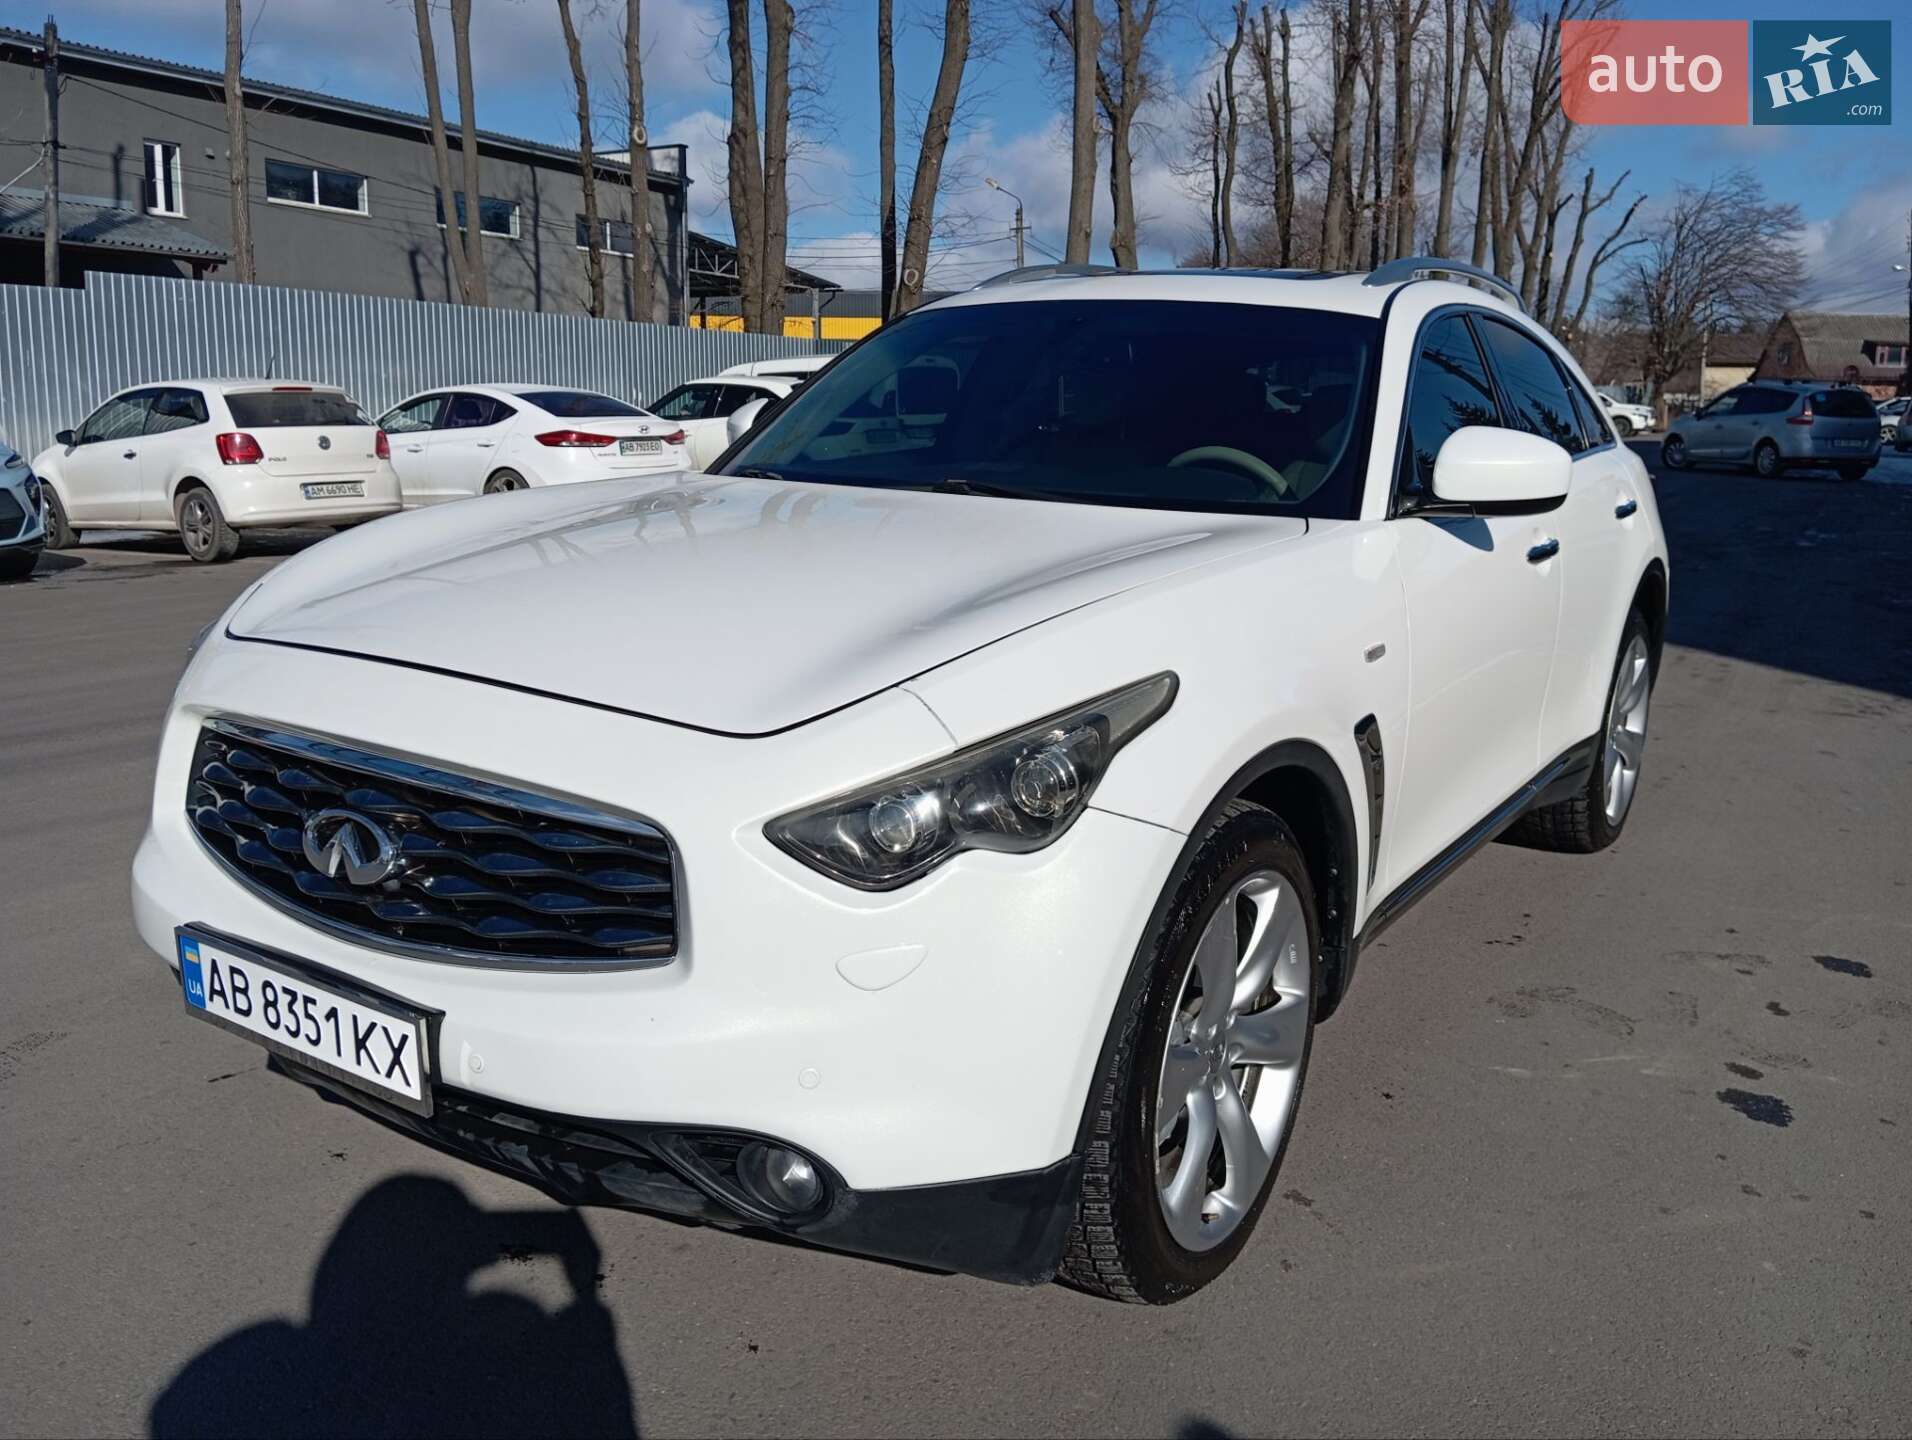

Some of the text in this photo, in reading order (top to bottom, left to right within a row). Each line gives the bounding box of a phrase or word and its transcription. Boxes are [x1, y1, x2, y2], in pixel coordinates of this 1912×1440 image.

[311, 486, 326, 496] AM
[326, 485, 347, 495] 6690
[188, 978, 204, 998] UA
[208, 958, 253, 1017] AB
[261, 979, 342, 1057] 8351
[351, 1013, 412, 1088] KX
